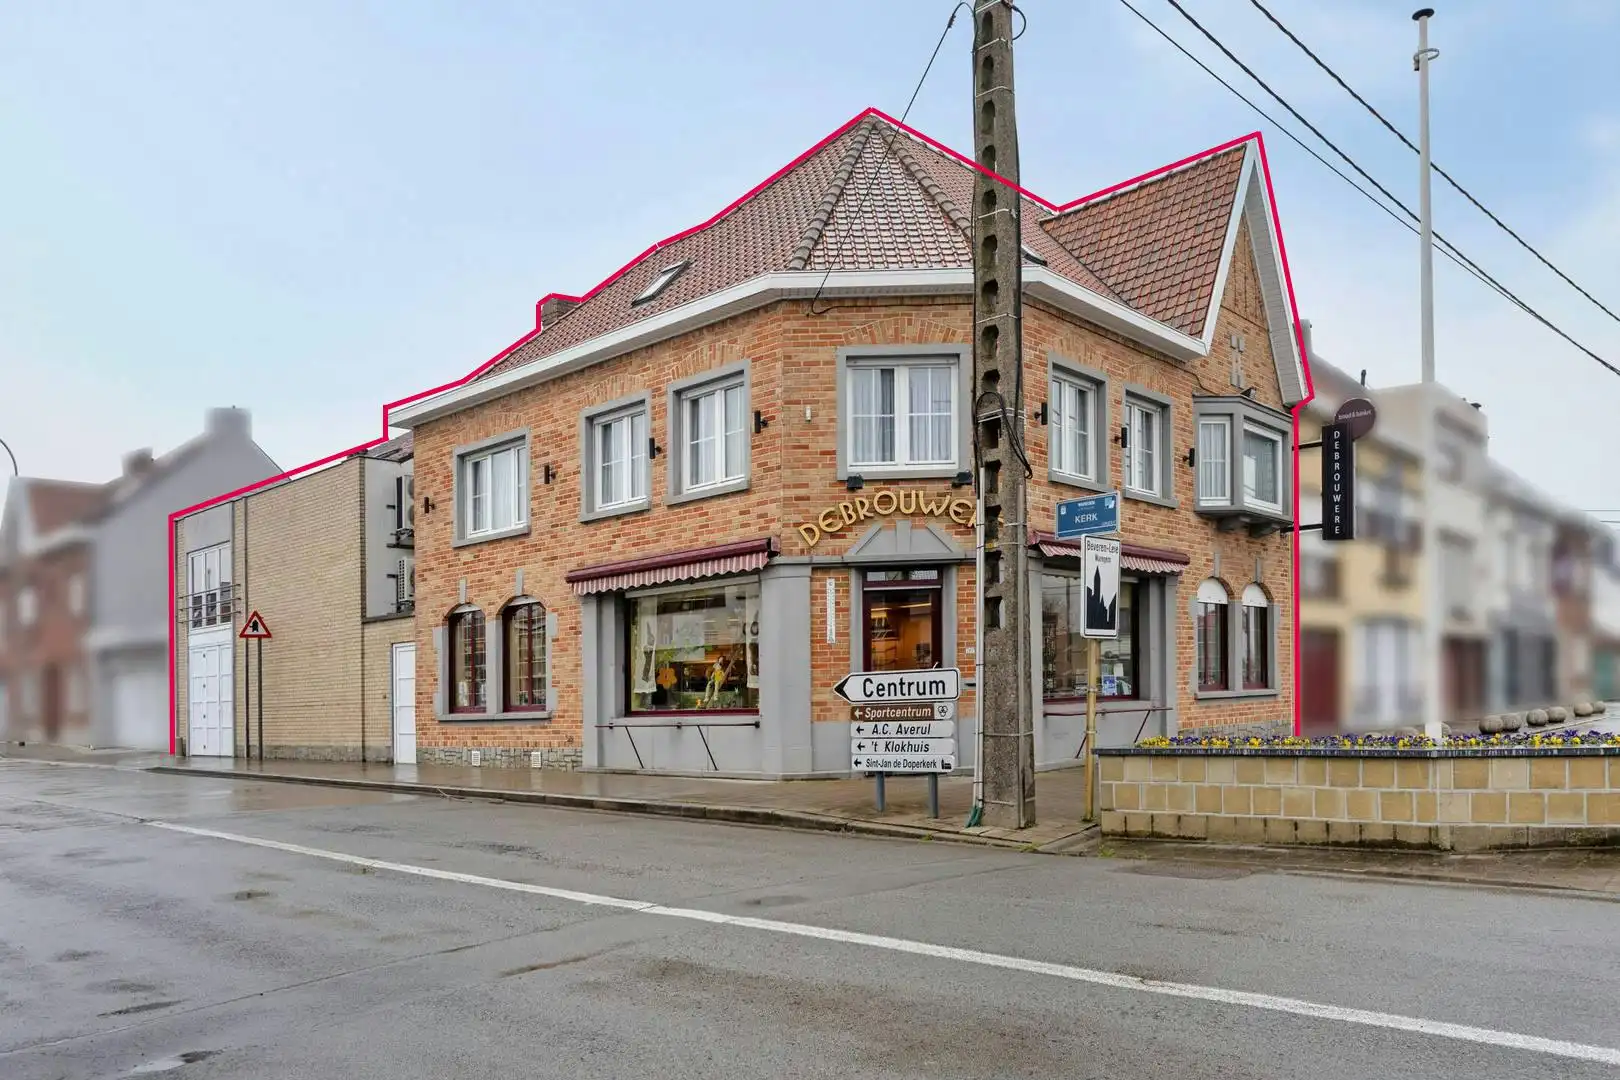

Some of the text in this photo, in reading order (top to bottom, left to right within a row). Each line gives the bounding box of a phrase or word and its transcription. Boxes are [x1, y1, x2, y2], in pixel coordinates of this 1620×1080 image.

[1333, 430, 1342, 534] DEBROUWERE
[798, 490, 977, 547] DEBROUWE
[1074, 513, 1098, 524] KERK
[862, 677, 946, 698] Centrum
[864, 707, 932, 720] Sportcentrum
[871, 723, 932, 736] A.C. Averul
[871, 741, 930, 753] 't Klokhuis
[866, 758, 938, 770] Sint-Jan de Doperkerk
